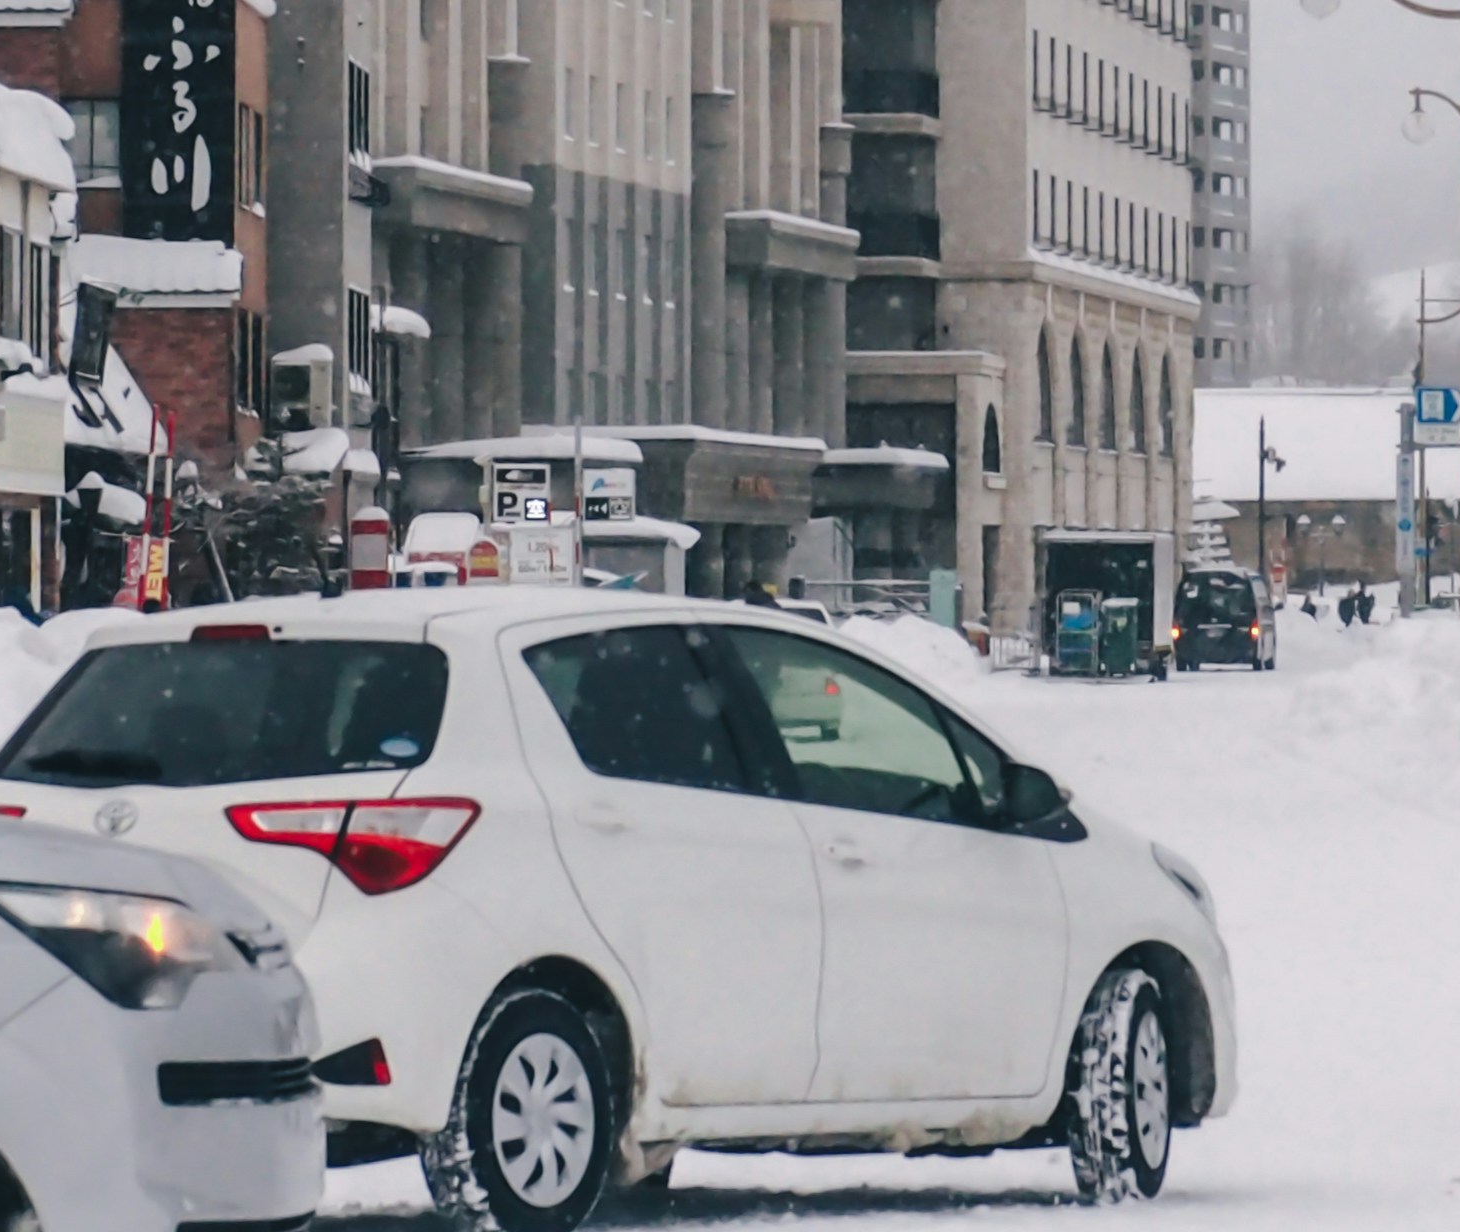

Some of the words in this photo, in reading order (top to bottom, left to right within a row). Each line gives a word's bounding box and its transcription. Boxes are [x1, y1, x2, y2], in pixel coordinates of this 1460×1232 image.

[142, 15, 221, 213] ふる川
[496, 491, 519, 517] P
